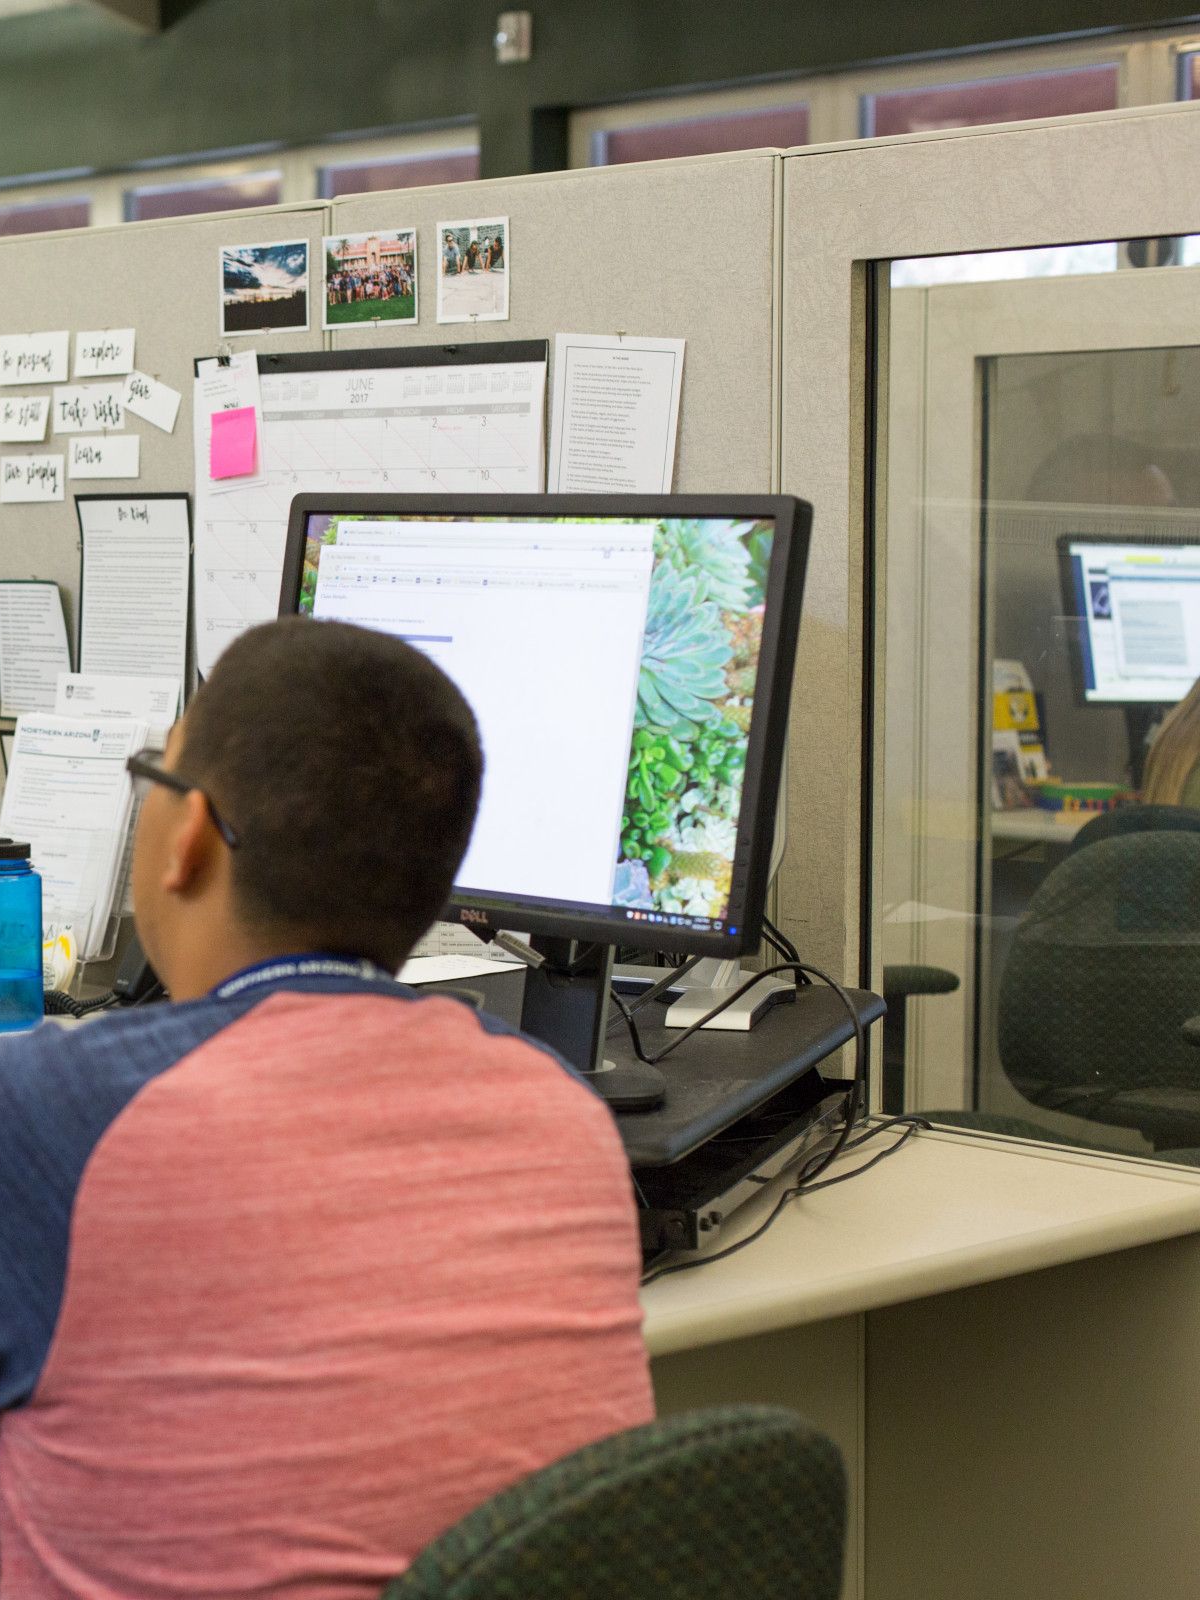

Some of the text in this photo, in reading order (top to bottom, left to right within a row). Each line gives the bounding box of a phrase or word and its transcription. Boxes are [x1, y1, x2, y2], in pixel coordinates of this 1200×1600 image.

[345, 377, 375, 392] JUNE
[350, 393, 369, 404] 2017
[431, 417, 438, 429] 2
[481, 415, 487, 427] 3
[383, 470, 389, 481] 8
[430, 470, 437, 481] 9
[481, 469, 490, 480] 10
[249, 523, 258, 534] 12
[20, 725, 62, 736] NORTHERN
[460, 909, 489, 924] DELL
